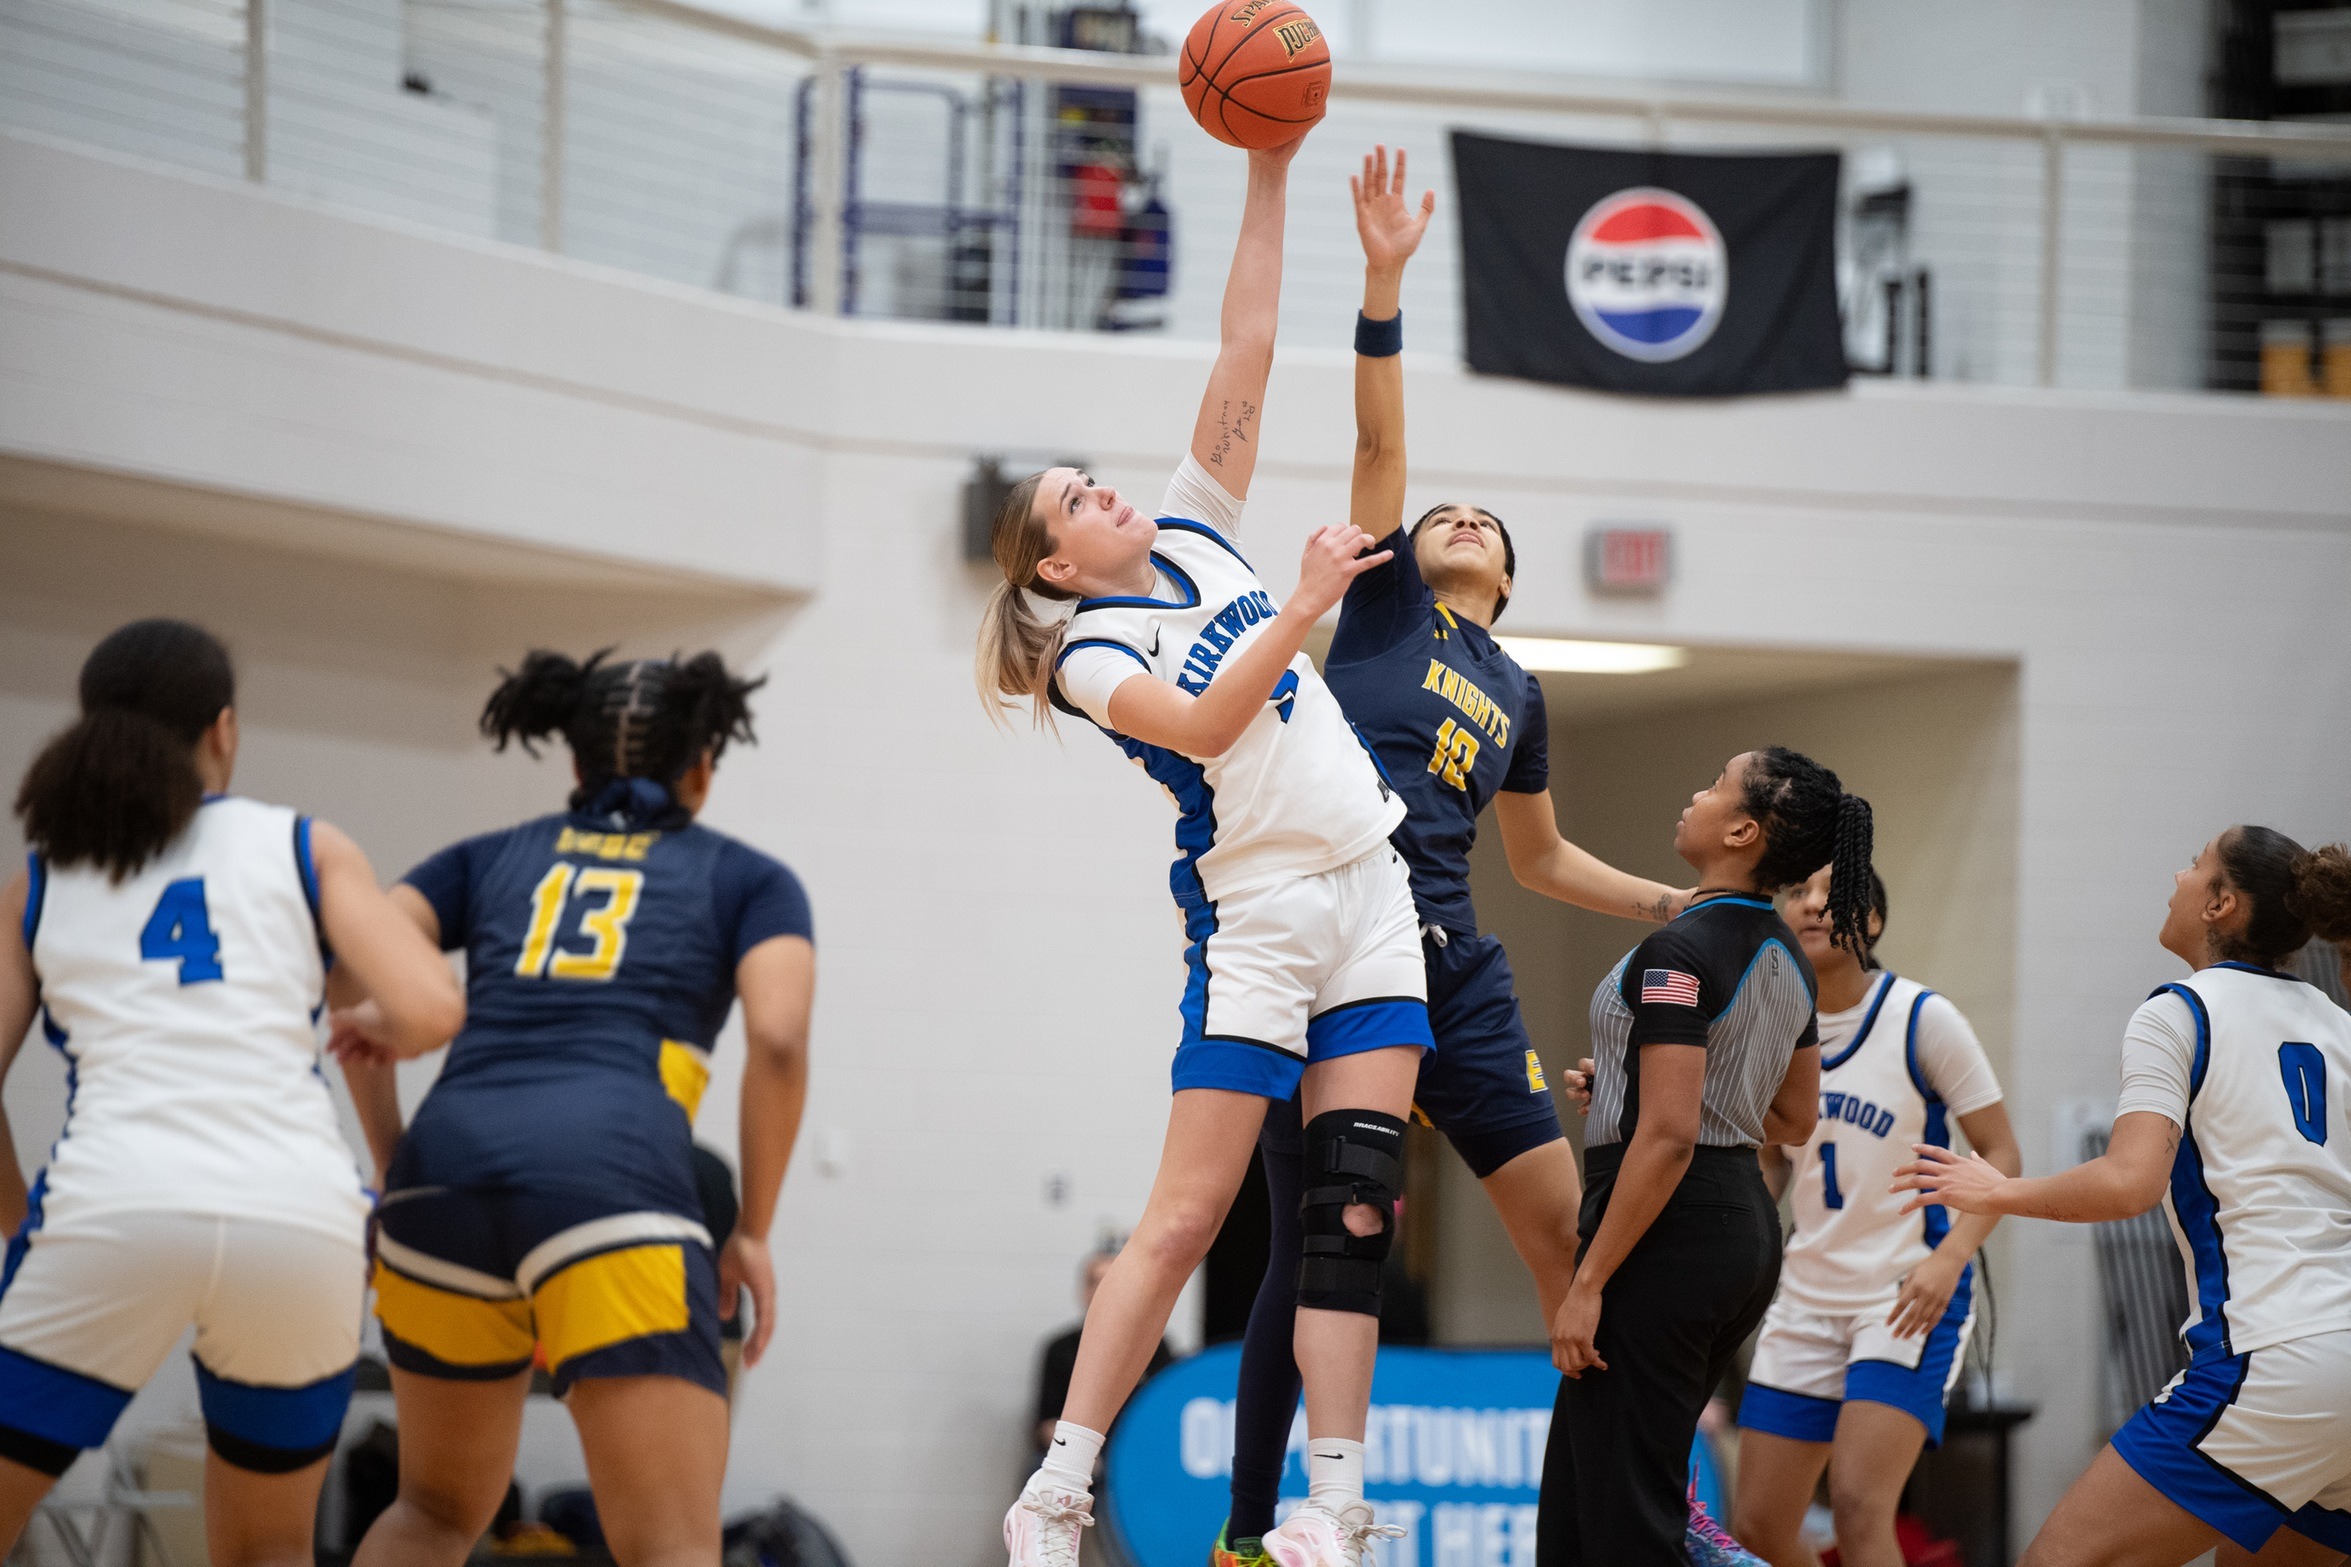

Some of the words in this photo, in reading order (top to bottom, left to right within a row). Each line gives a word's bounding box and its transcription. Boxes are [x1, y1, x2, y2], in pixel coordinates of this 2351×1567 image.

[1421, 658, 1511, 749] KNIGHTS
[1427, 716, 1480, 792] 10
[138, 876, 224, 987] 4
[513, 859, 645, 982] 13
[1819, 1091, 1895, 1138] WOOD
[2278, 1041, 2327, 1147] 0
[1818, 1141, 1844, 1211] 1
